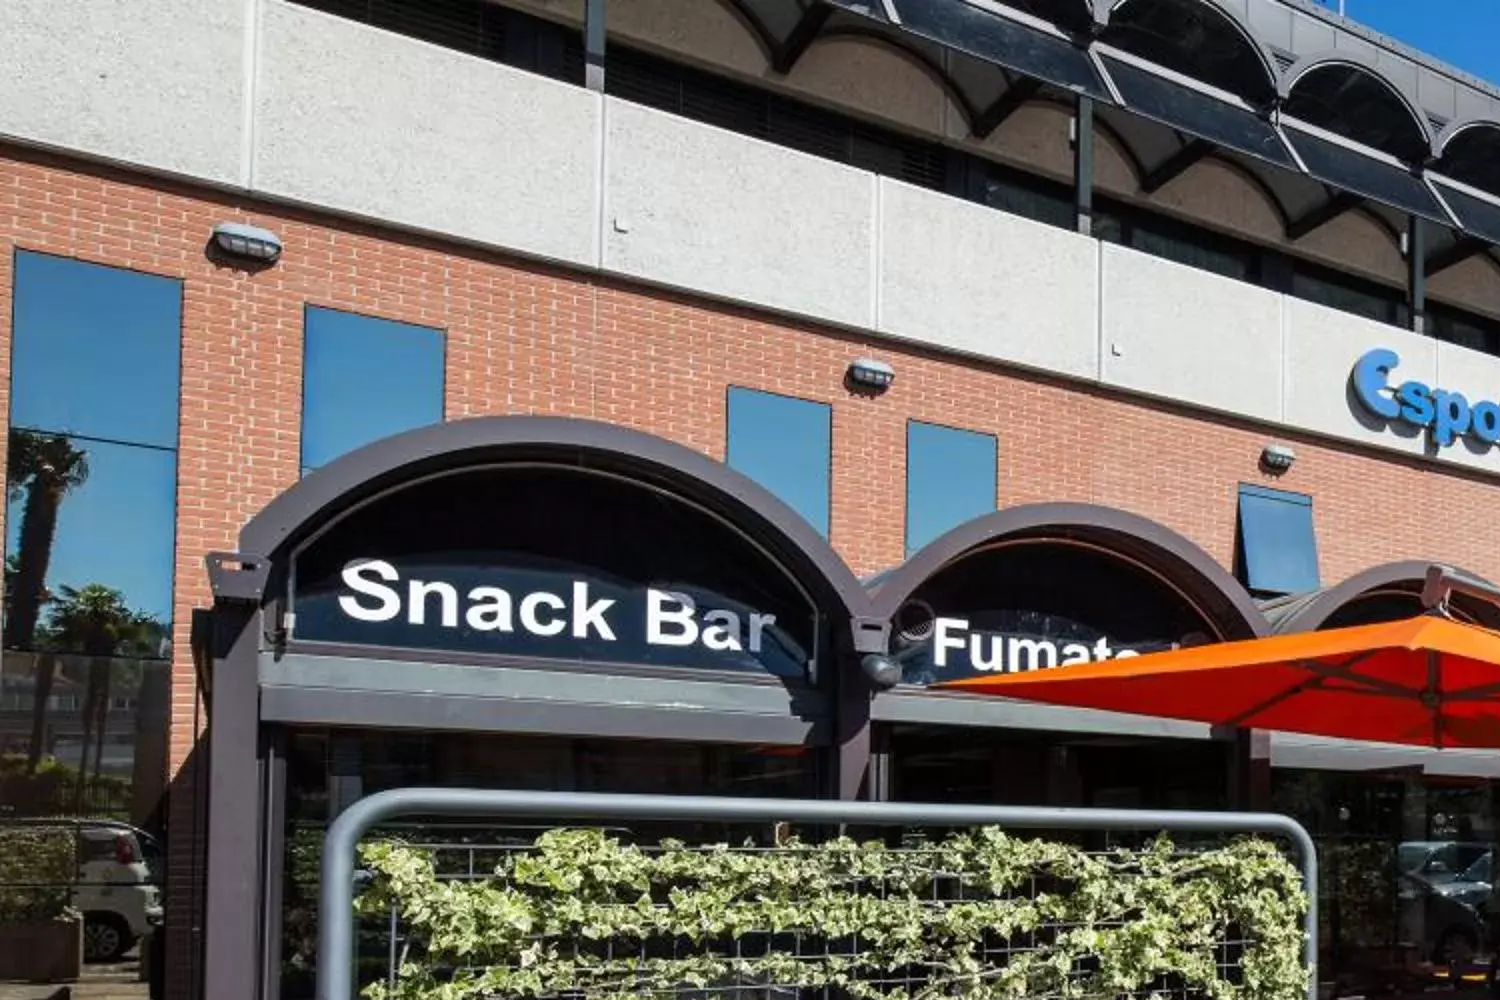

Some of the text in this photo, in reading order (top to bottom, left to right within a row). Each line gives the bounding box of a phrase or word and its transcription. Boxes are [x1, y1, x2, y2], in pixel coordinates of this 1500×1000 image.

[337, 557, 777, 653] Snack Bar
[933, 616, 1181, 674] Fumat
